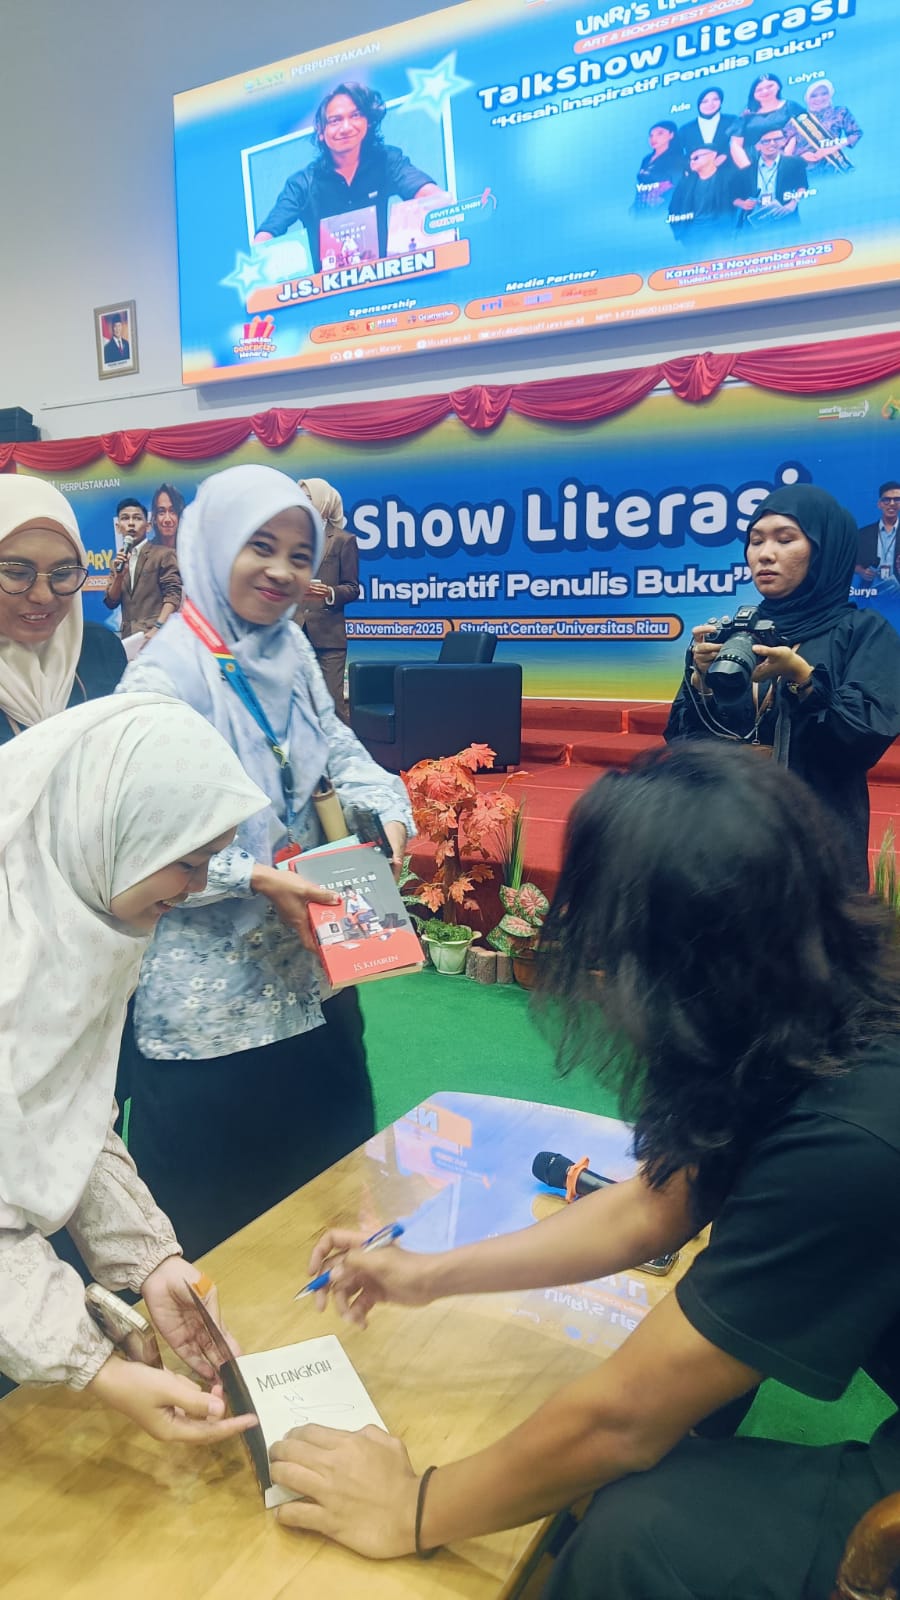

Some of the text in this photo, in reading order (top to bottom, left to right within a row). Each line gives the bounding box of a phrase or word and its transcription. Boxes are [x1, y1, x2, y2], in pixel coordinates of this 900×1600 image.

[574, 2, 650, 35] UNRI'S
[291, 43, 381, 77] PERPUSTAKAAN
[562, 76, 660, 112] Inspiratif
[663, 55, 750, 86] Penulis
[755, 30, 836, 63] Buku”
[818, 137, 849, 149] Tirta
[636, 182, 660, 193] Yaya
[783, 187, 817, 201] Surya
[665, 244, 833, 280] Kamis, 13 November 2025
[278, 250, 435, 301] J.S. KHAIREN
[505, 277, 545, 292] Media
[546, 269, 598, 285] Partner
[349, 298, 417, 318] Sponsorship
[60, 479, 121, 492] PERPUSTAKAAN
[344, 467, 799, 550] Show Literas
[87, 549, 113, 570] ARY
[371, 574, 500, 605] Inspiratif
[506, 570, 628, 598] Penulis
[849, 586, 878, 598] Surya
[356, 622, 413, 634] November
[415, 622, 443, 634] 2025
[460, 620, 669, 635] Student Center Universitas Riau
[256, 1359, 333, 1392] MELANGKAH
